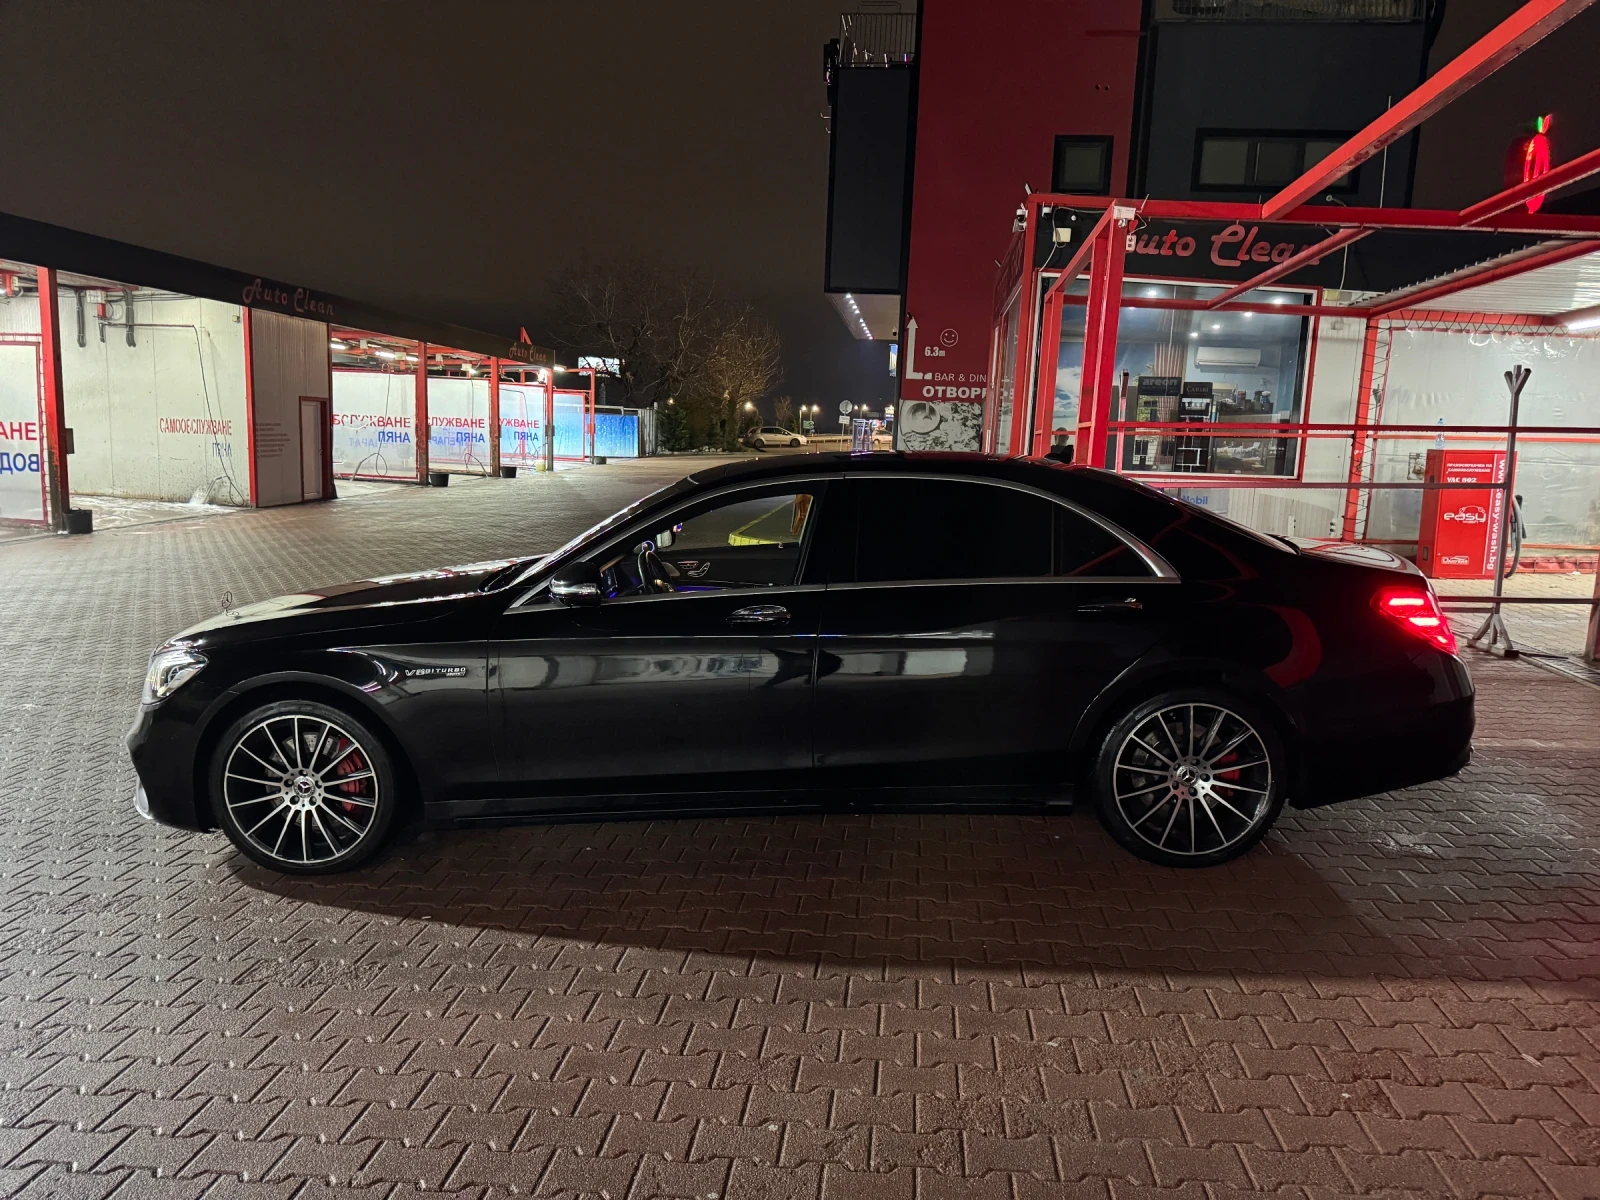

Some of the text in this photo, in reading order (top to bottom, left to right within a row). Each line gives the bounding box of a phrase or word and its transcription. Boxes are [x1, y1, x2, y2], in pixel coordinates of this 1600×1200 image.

[1126, 219, 1320, 267] uto Clea
[242, 278, 334, 316] Auto Clean
[924, 346, 946, 357] 6.3m
[934, 372, 955, 382] BAR
[958, 374, 966, 382] &
[1142, 378, 1178, 386] areon
[377, 431, 411, 443] ПЯНА
[456, 431, 486, 443] ПЯНА
[513, 430, 540, 441] ПЯНА
[1182, 496, 1208, 505] Mobil
[1443, 512, 1486, 523] easy
